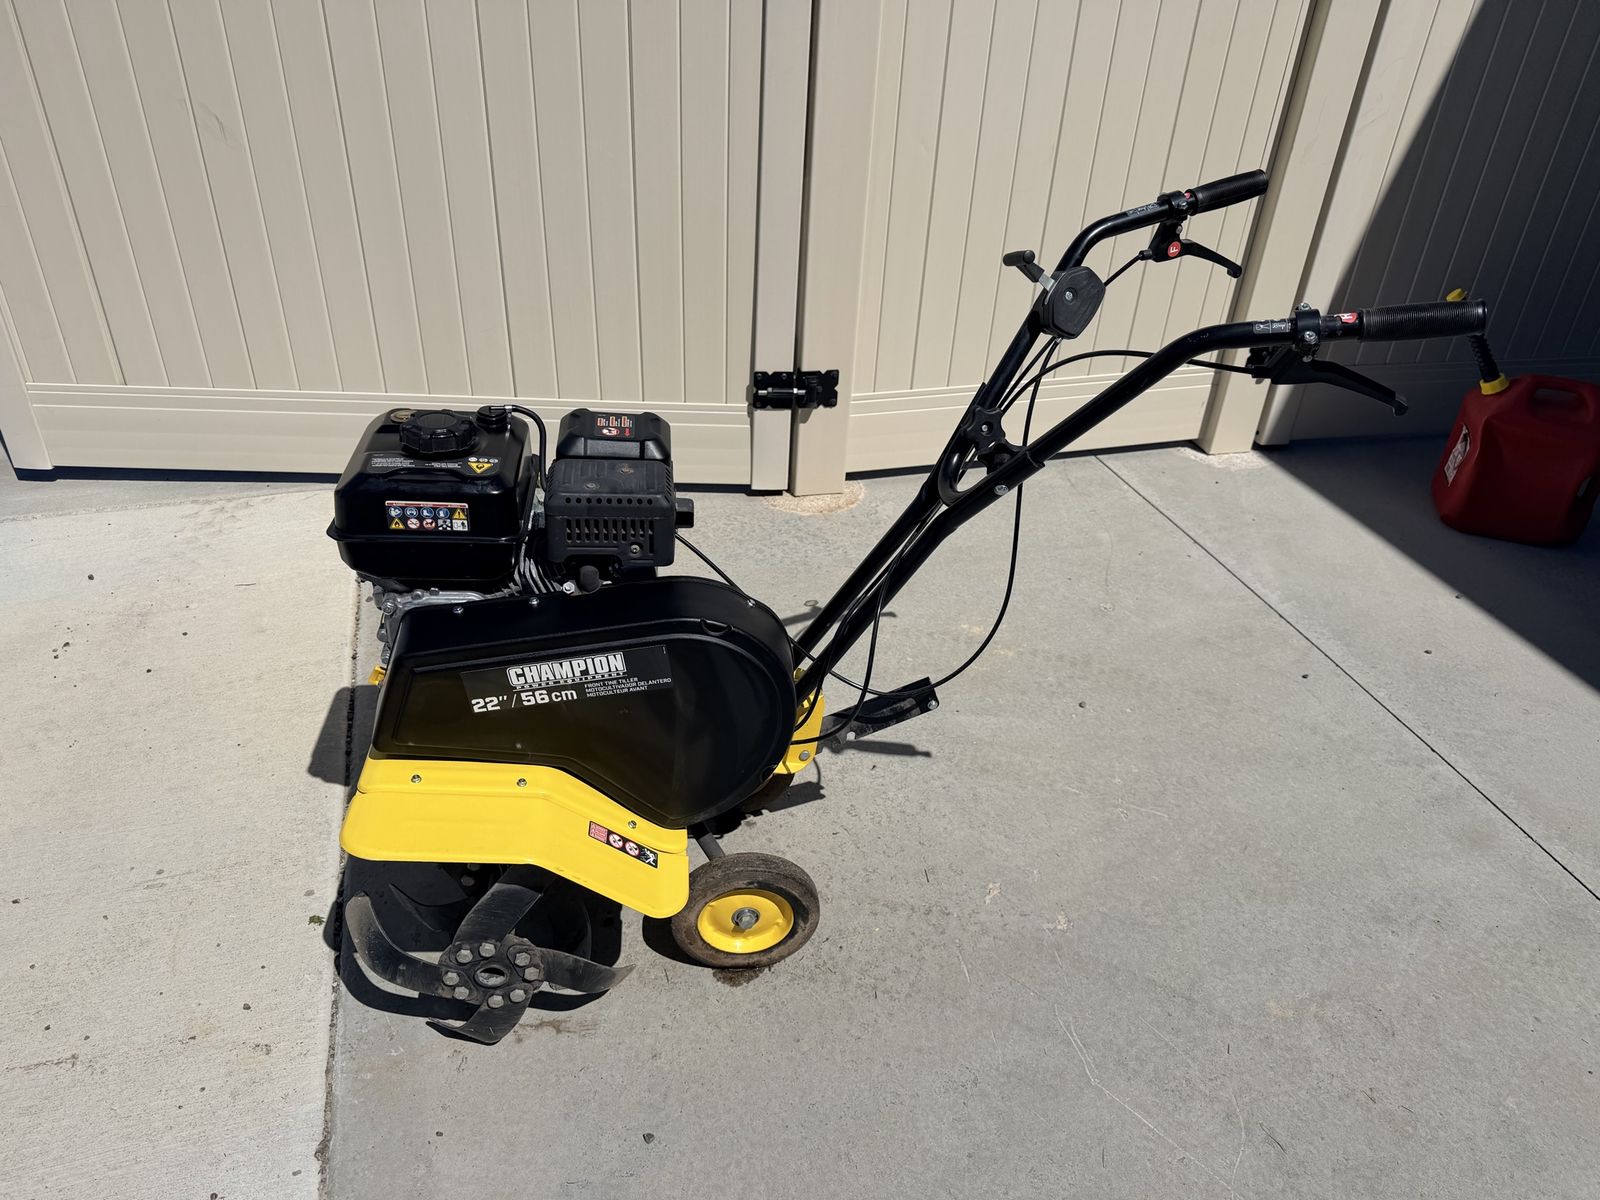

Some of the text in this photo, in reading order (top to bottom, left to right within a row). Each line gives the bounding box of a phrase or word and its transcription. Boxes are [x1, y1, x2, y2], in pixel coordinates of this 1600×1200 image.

[508, 653, 625, 686] CHAMPION
[516, 672, 626, 690] POWER EQUIPMENT
[585, 677, 672, 693] MOTOCULTIVADOR DELANTERO
[520, 690, 550, 706] 56
[551, 689, 578, 702] cm
[586, 688, 628, 697] MOTOCULTEUR
